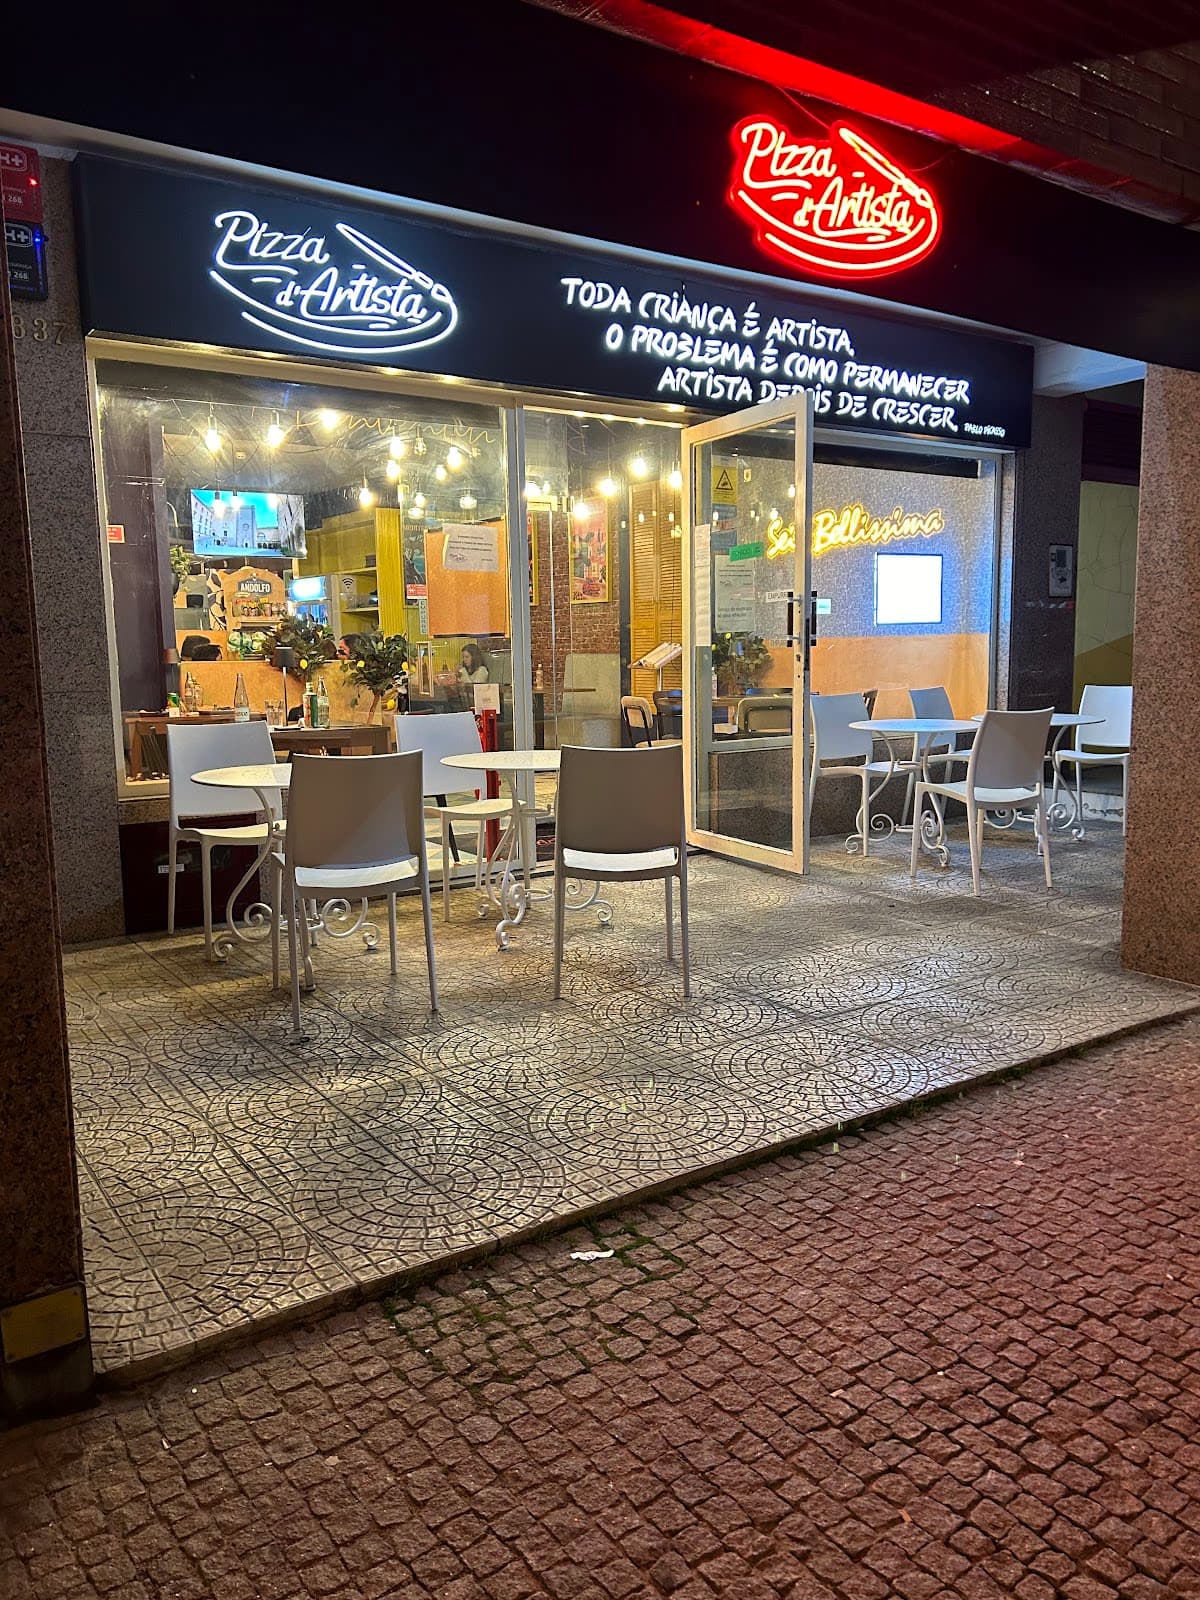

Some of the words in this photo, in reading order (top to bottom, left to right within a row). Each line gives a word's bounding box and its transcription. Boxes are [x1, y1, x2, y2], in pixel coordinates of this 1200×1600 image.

[741, 122, 837, 189] Pizza
[793, 176, 914, 237] d'Artista
[214, 210, 330, 275] Pizza
[276, 267, 428, 324] d'Artista
[560, 277, 632, 314] TODA
[638, 291, 737, 334] CRIANÇA
[742, 301, 761, 337] É
[605, 322, 624, 350] O
[631, 324, 756, 371] PROBLEMA
[760, 338, 779, 374] É
[783, 351, 838, 385] COMO
[843, 361, 970, 405] PERMANECER
[657, 365, 753, 402] ARTISTA
[836, 391, 868, 418] DE
[871, 397, 959, 433] CRESCER.
[963, 422, 983, 435] PABLO
[983, 424, 1006, 438] PICASSO
[812, 503, 944, 556] Bellissima
[240, 583, 271, 593] ANDOLFO
